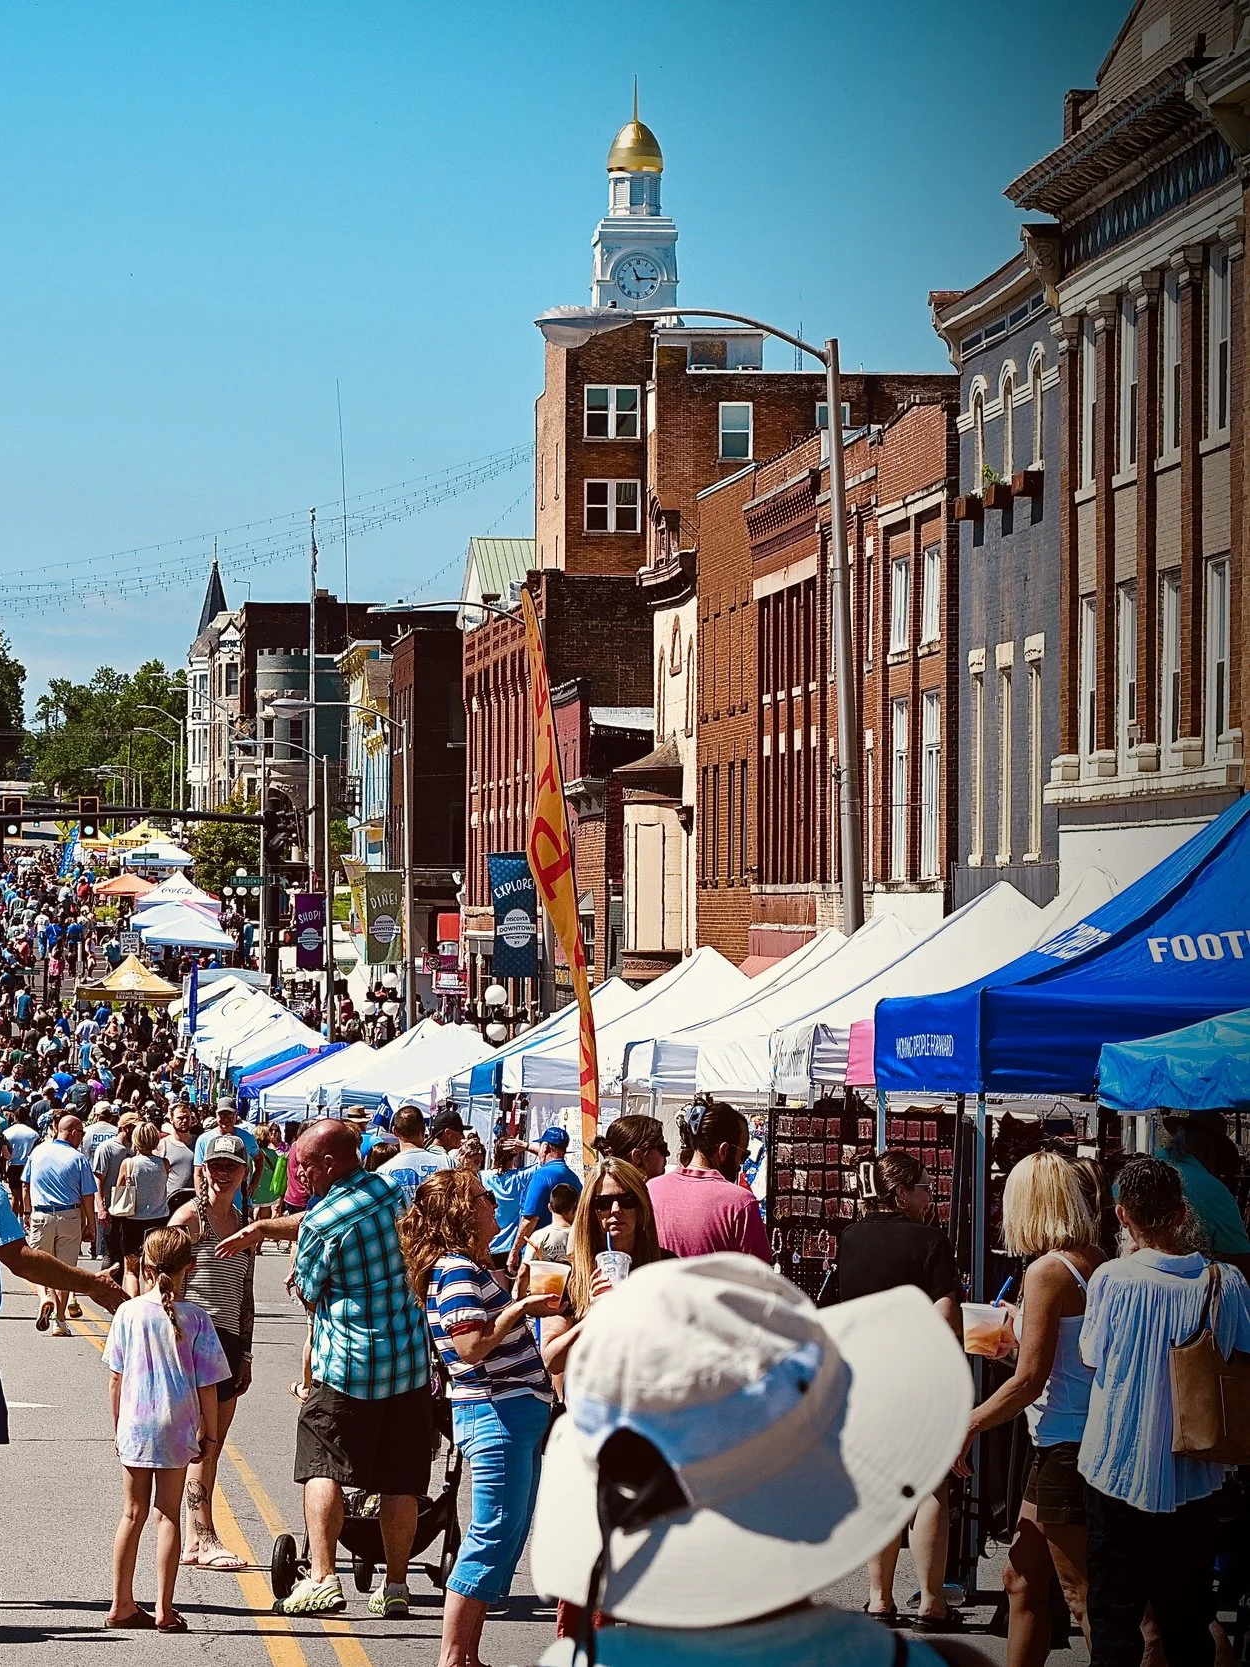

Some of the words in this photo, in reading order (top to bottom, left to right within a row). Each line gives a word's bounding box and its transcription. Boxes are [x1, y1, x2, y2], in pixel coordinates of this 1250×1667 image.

[493, 877, 535, 899] EXPLORE!
[370, 893, 398, 909] DINE!
[298, 910, 321, 924] SHOP!
[500, 925, 535, 933] DOWNTOWN
[122, 944, 138, 953] 25
[1147, 930, 1250, 963] FOOT
[913, 1034, 930, 1057] PEOPLE
[930, 1034, 954, 1057] FORWARD
